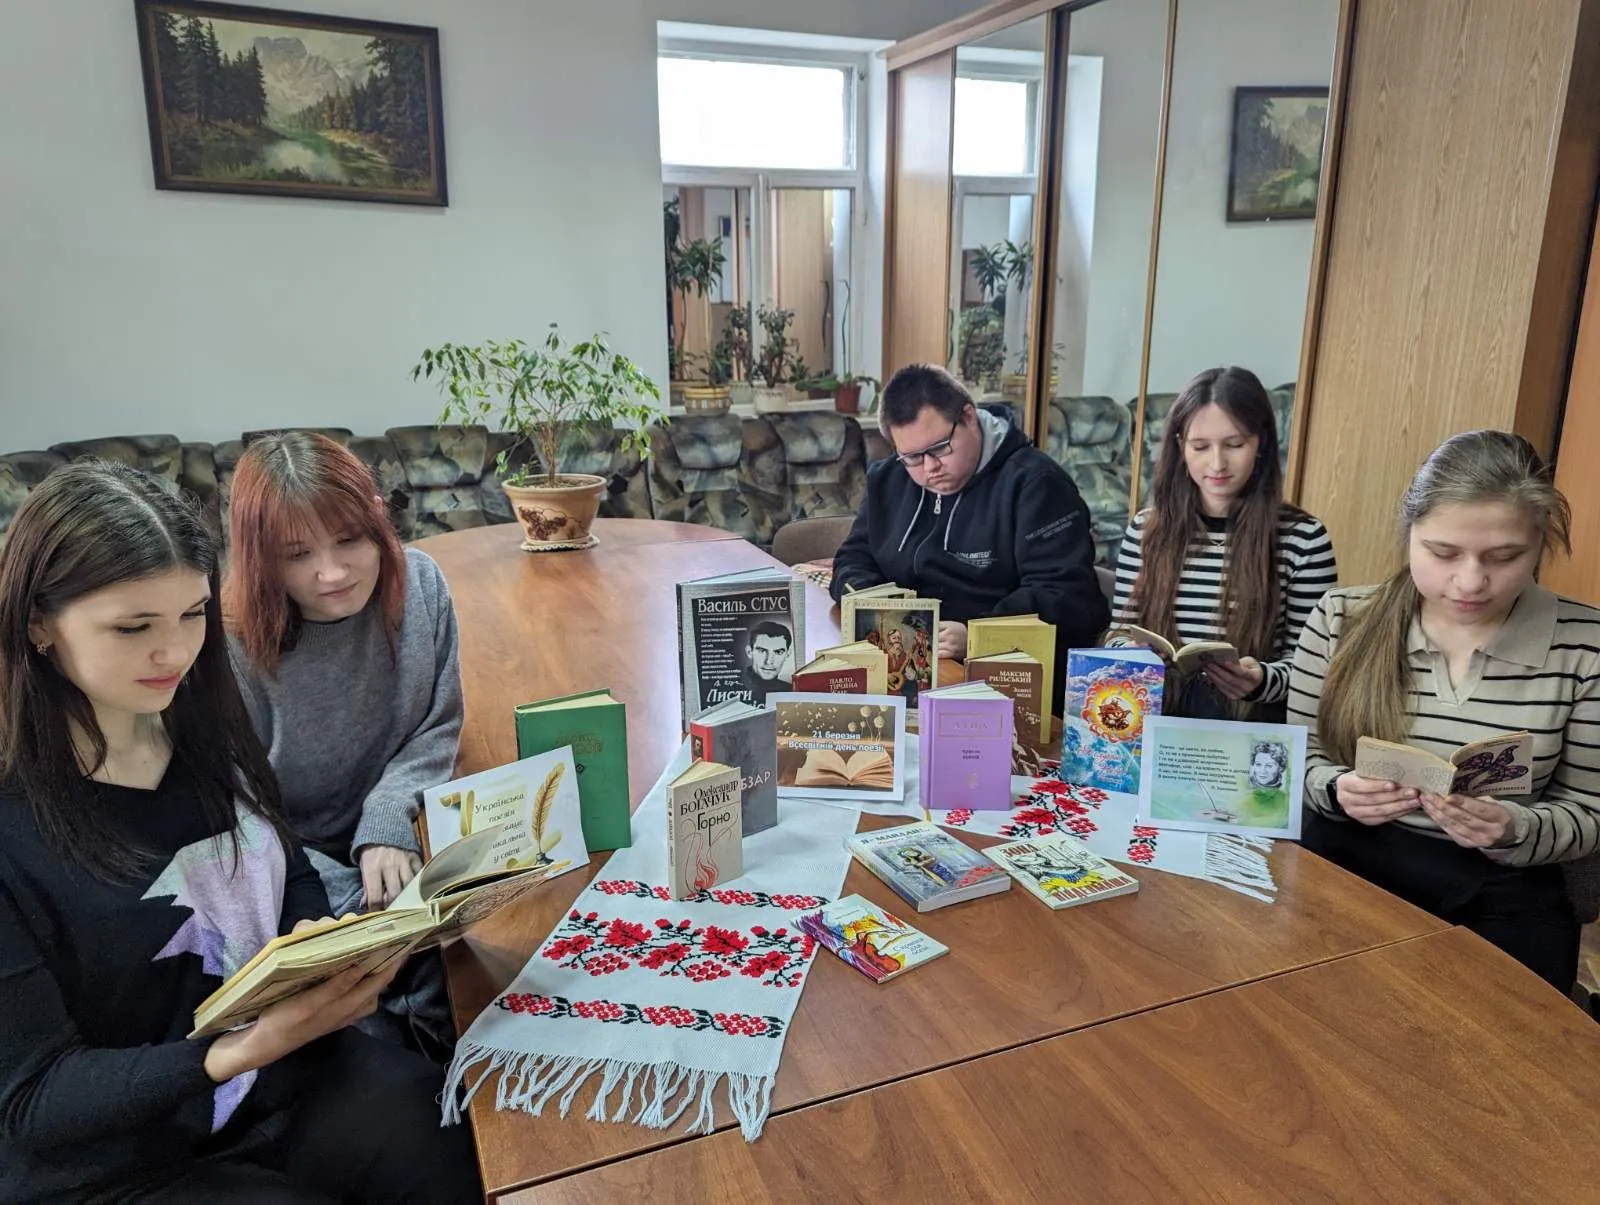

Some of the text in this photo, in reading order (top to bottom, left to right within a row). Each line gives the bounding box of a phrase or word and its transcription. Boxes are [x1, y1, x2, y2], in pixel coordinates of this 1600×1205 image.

[698, 596, 788, 613] Василь СТУС
[989, 676, 1031, 684] РИЛЬСЬКИЙ
[707, 689, 752, 703] Листи
[812, 730, 861, 740] 21 березня
[788, 740, 884, 752] Всесвітній день поезії
[741, 771, 771, 790] БЗАР
[475, 793, 524, 814] Українська
[680, 792, 730, 816] БОГАЧУК
[698, 812, 730, 847] Горно
